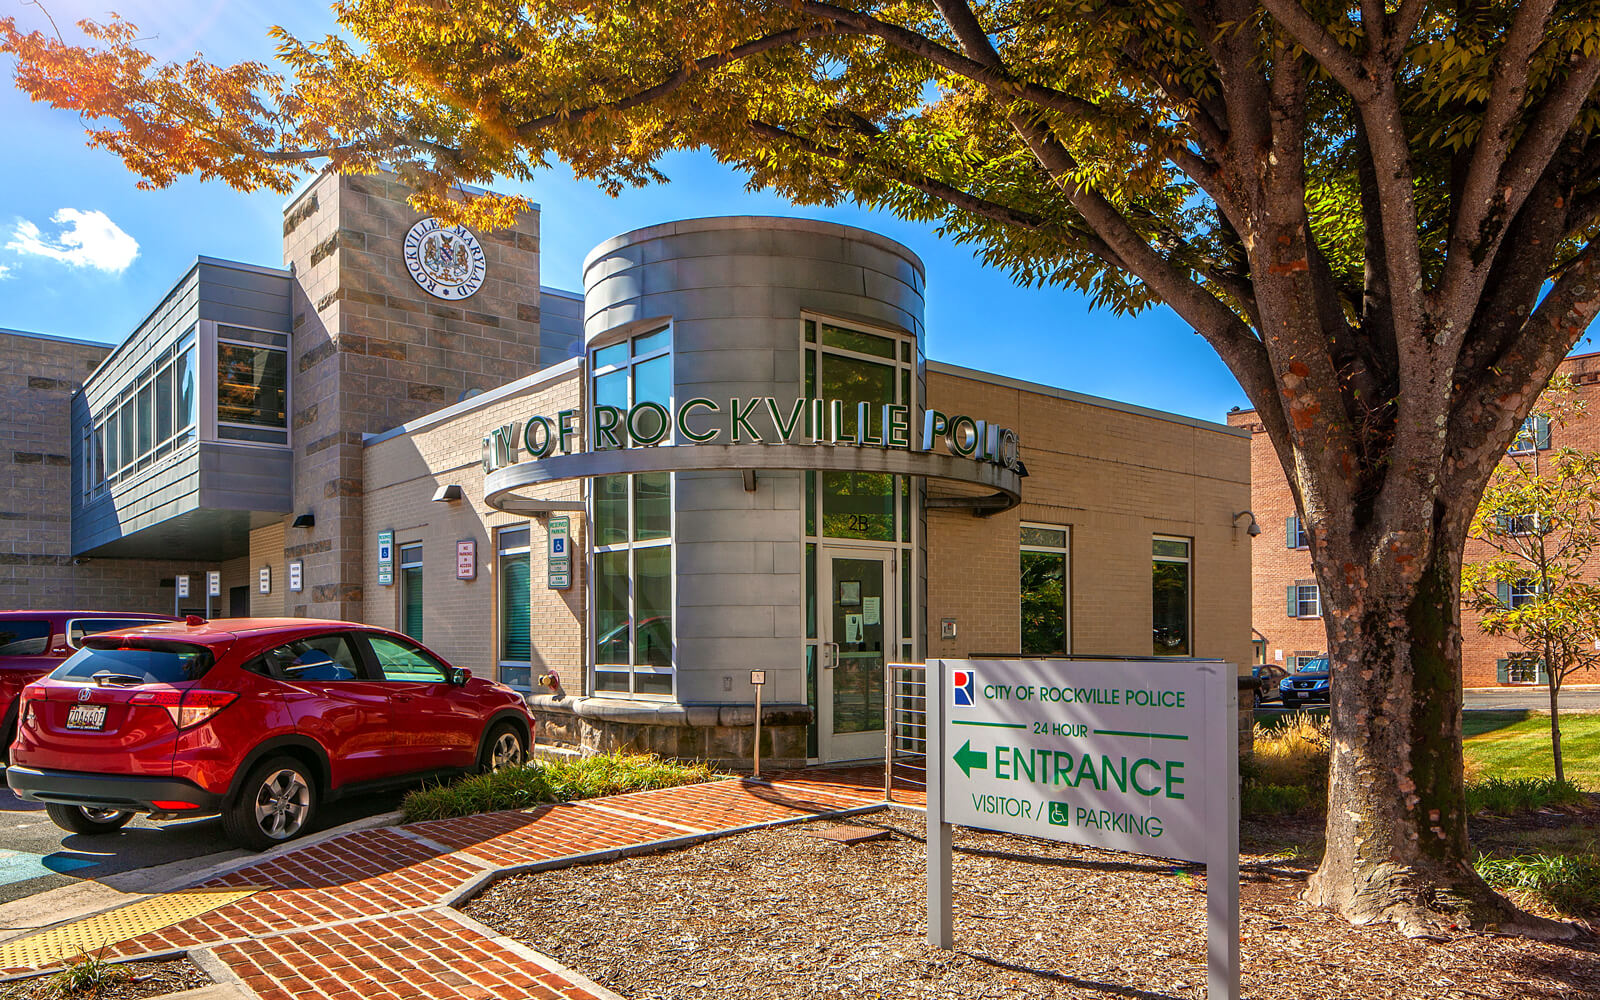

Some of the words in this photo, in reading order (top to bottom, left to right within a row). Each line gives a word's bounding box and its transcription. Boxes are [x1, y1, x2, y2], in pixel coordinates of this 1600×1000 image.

[406, 219, 440, 292] ROCKVILLE
[454, 225, 486, 297] MARYLAND
[524, 409, 578, 458] OF
[594, 397, 909, 448] ROCKVILLE
[849, 514, 869, 532] 2B
[983, 684, 1011, 700] CITY
[1016, 686, 1035, 701] OF
[1040, 687, 1120, 705] ROCKVILLE
[1126, 690, 1185, 708] POLICE
[1033, 722, 1048, 735] 24
[1052, 723, 1088, 738] HOUR
[995, 745, 1185, 799] ENTRANCE
[972, 793, 1031, 819] VISITOR
[1076, 807, 1163, 838] PARKING
